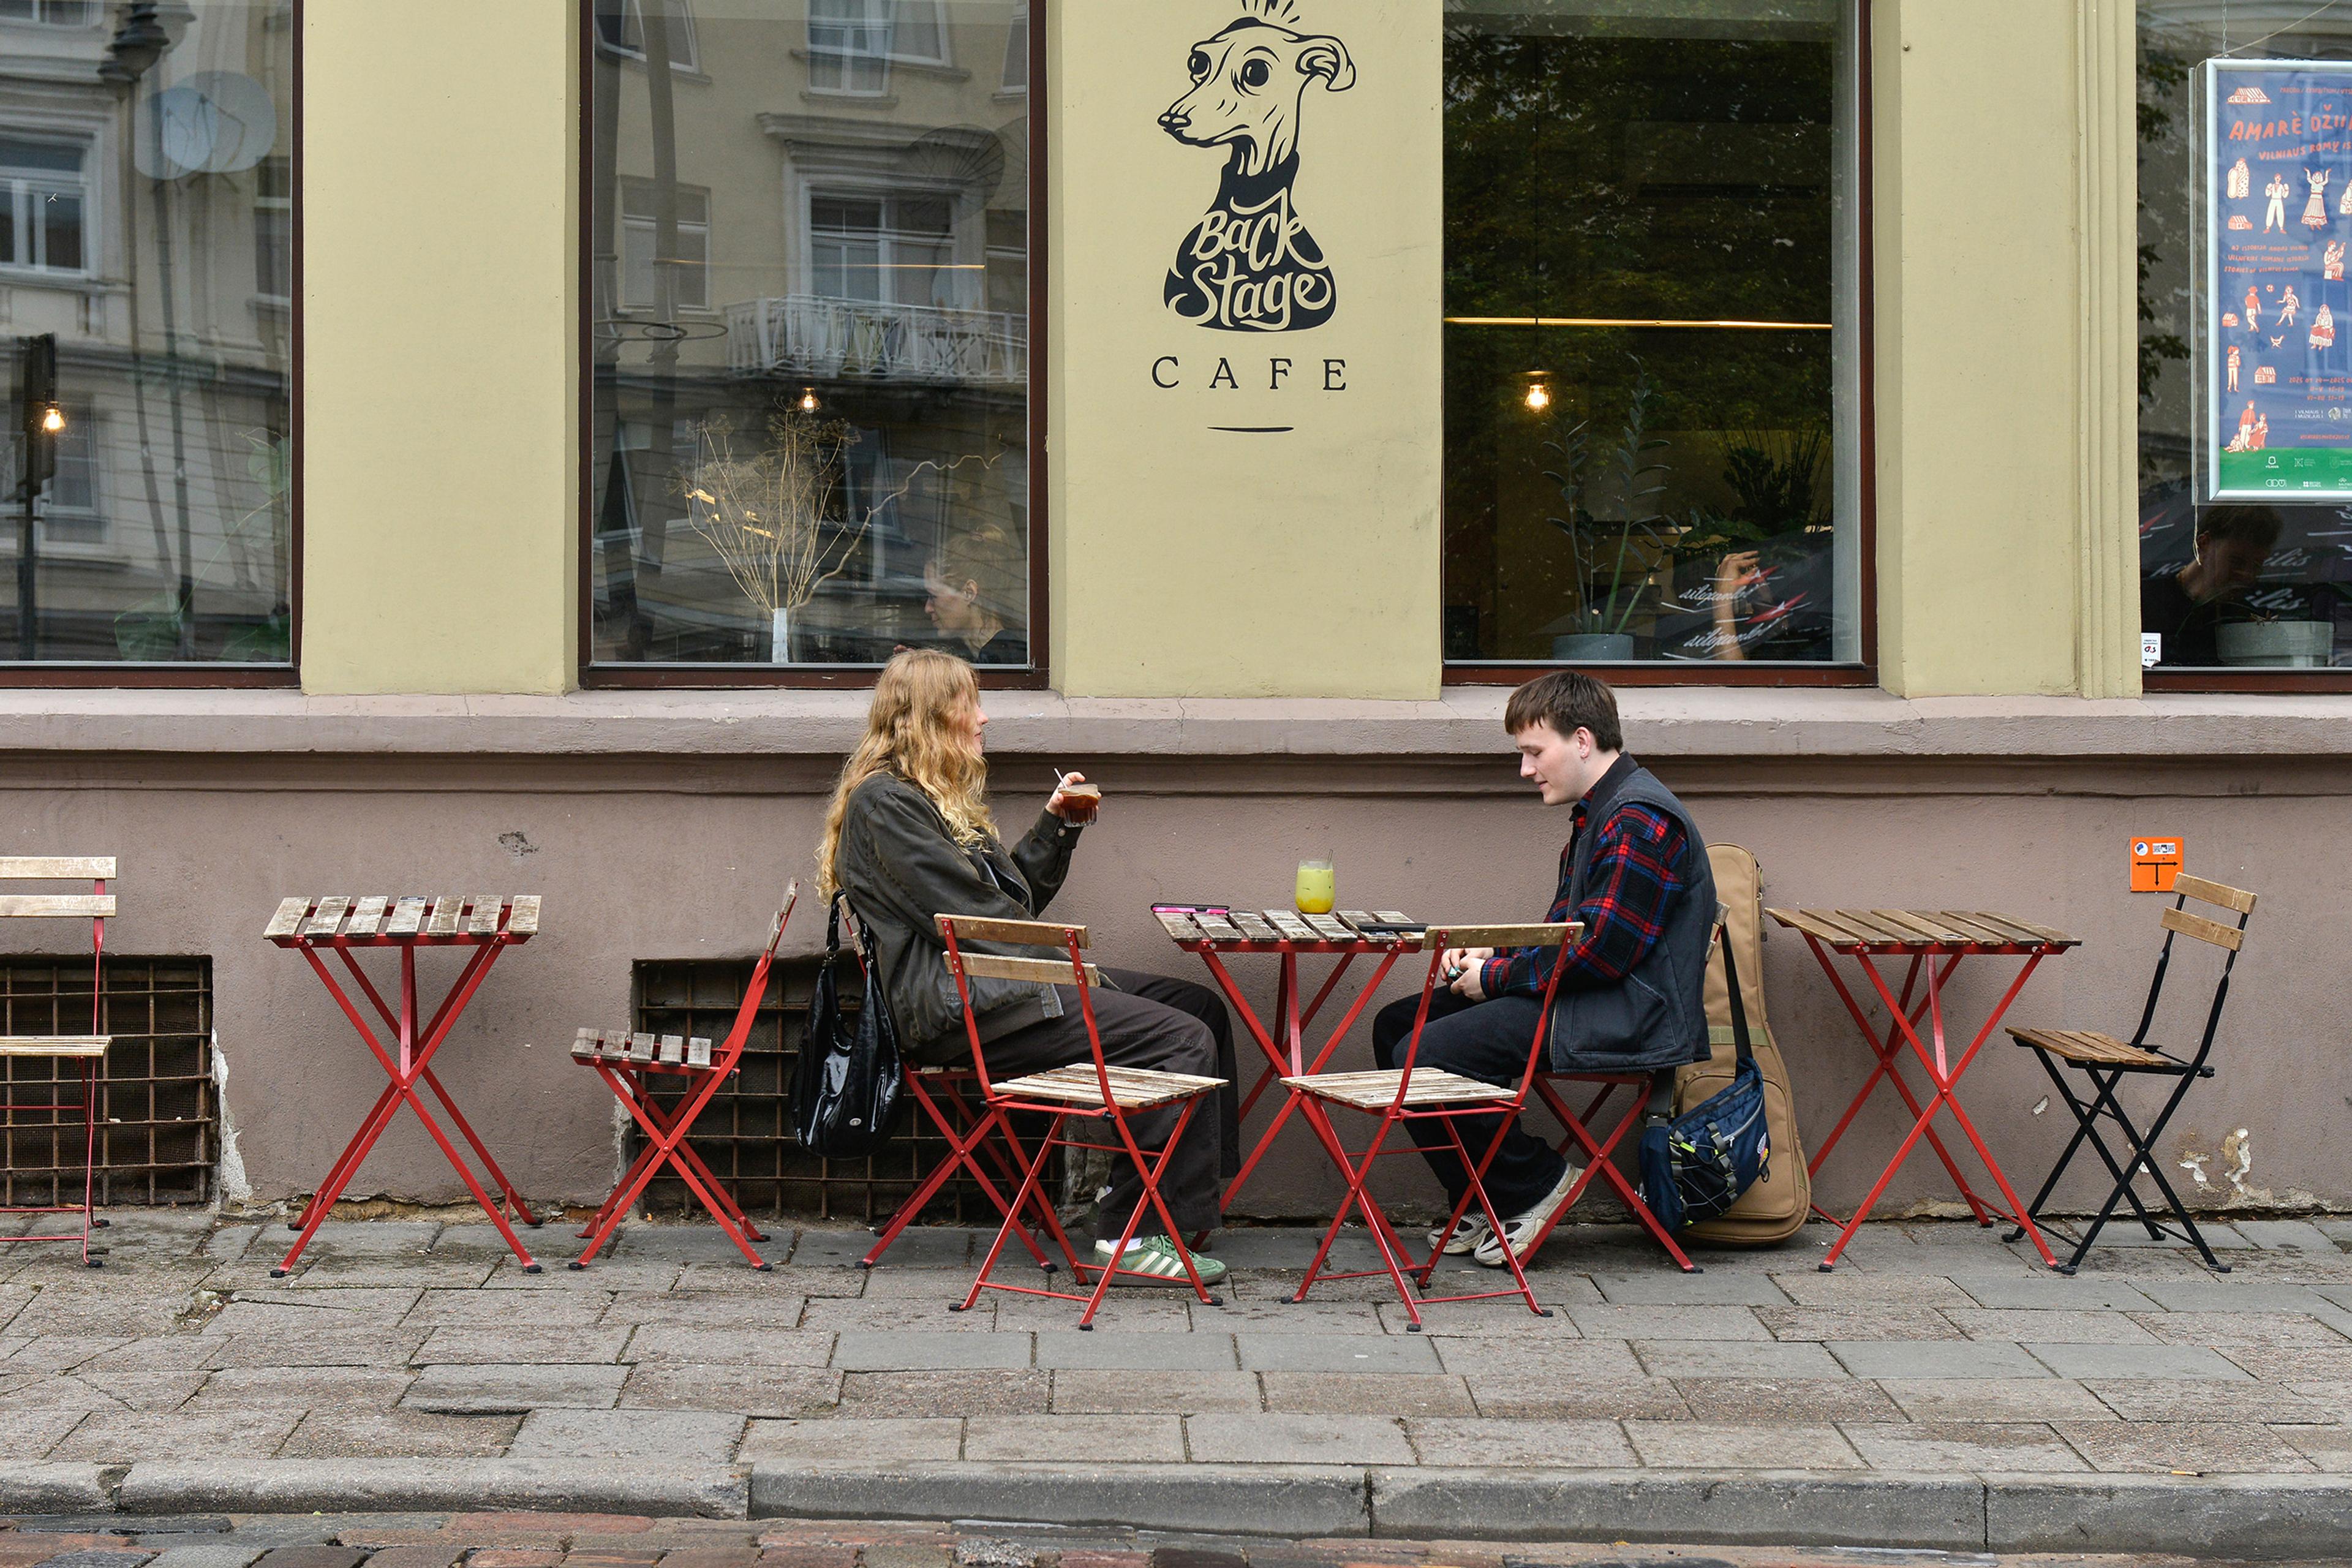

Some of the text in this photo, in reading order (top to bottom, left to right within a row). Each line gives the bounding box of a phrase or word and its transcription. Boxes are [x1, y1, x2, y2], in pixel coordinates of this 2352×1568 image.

[2228, 110, 2302, 141] AMARÈ
[2259, 146, 2306, 160] VILNIAUS
[1190, 187, 1329, 272] Back
[1169, 253, 1332, 330] Stage
[1152, 356, 1347, 391] CAFE
